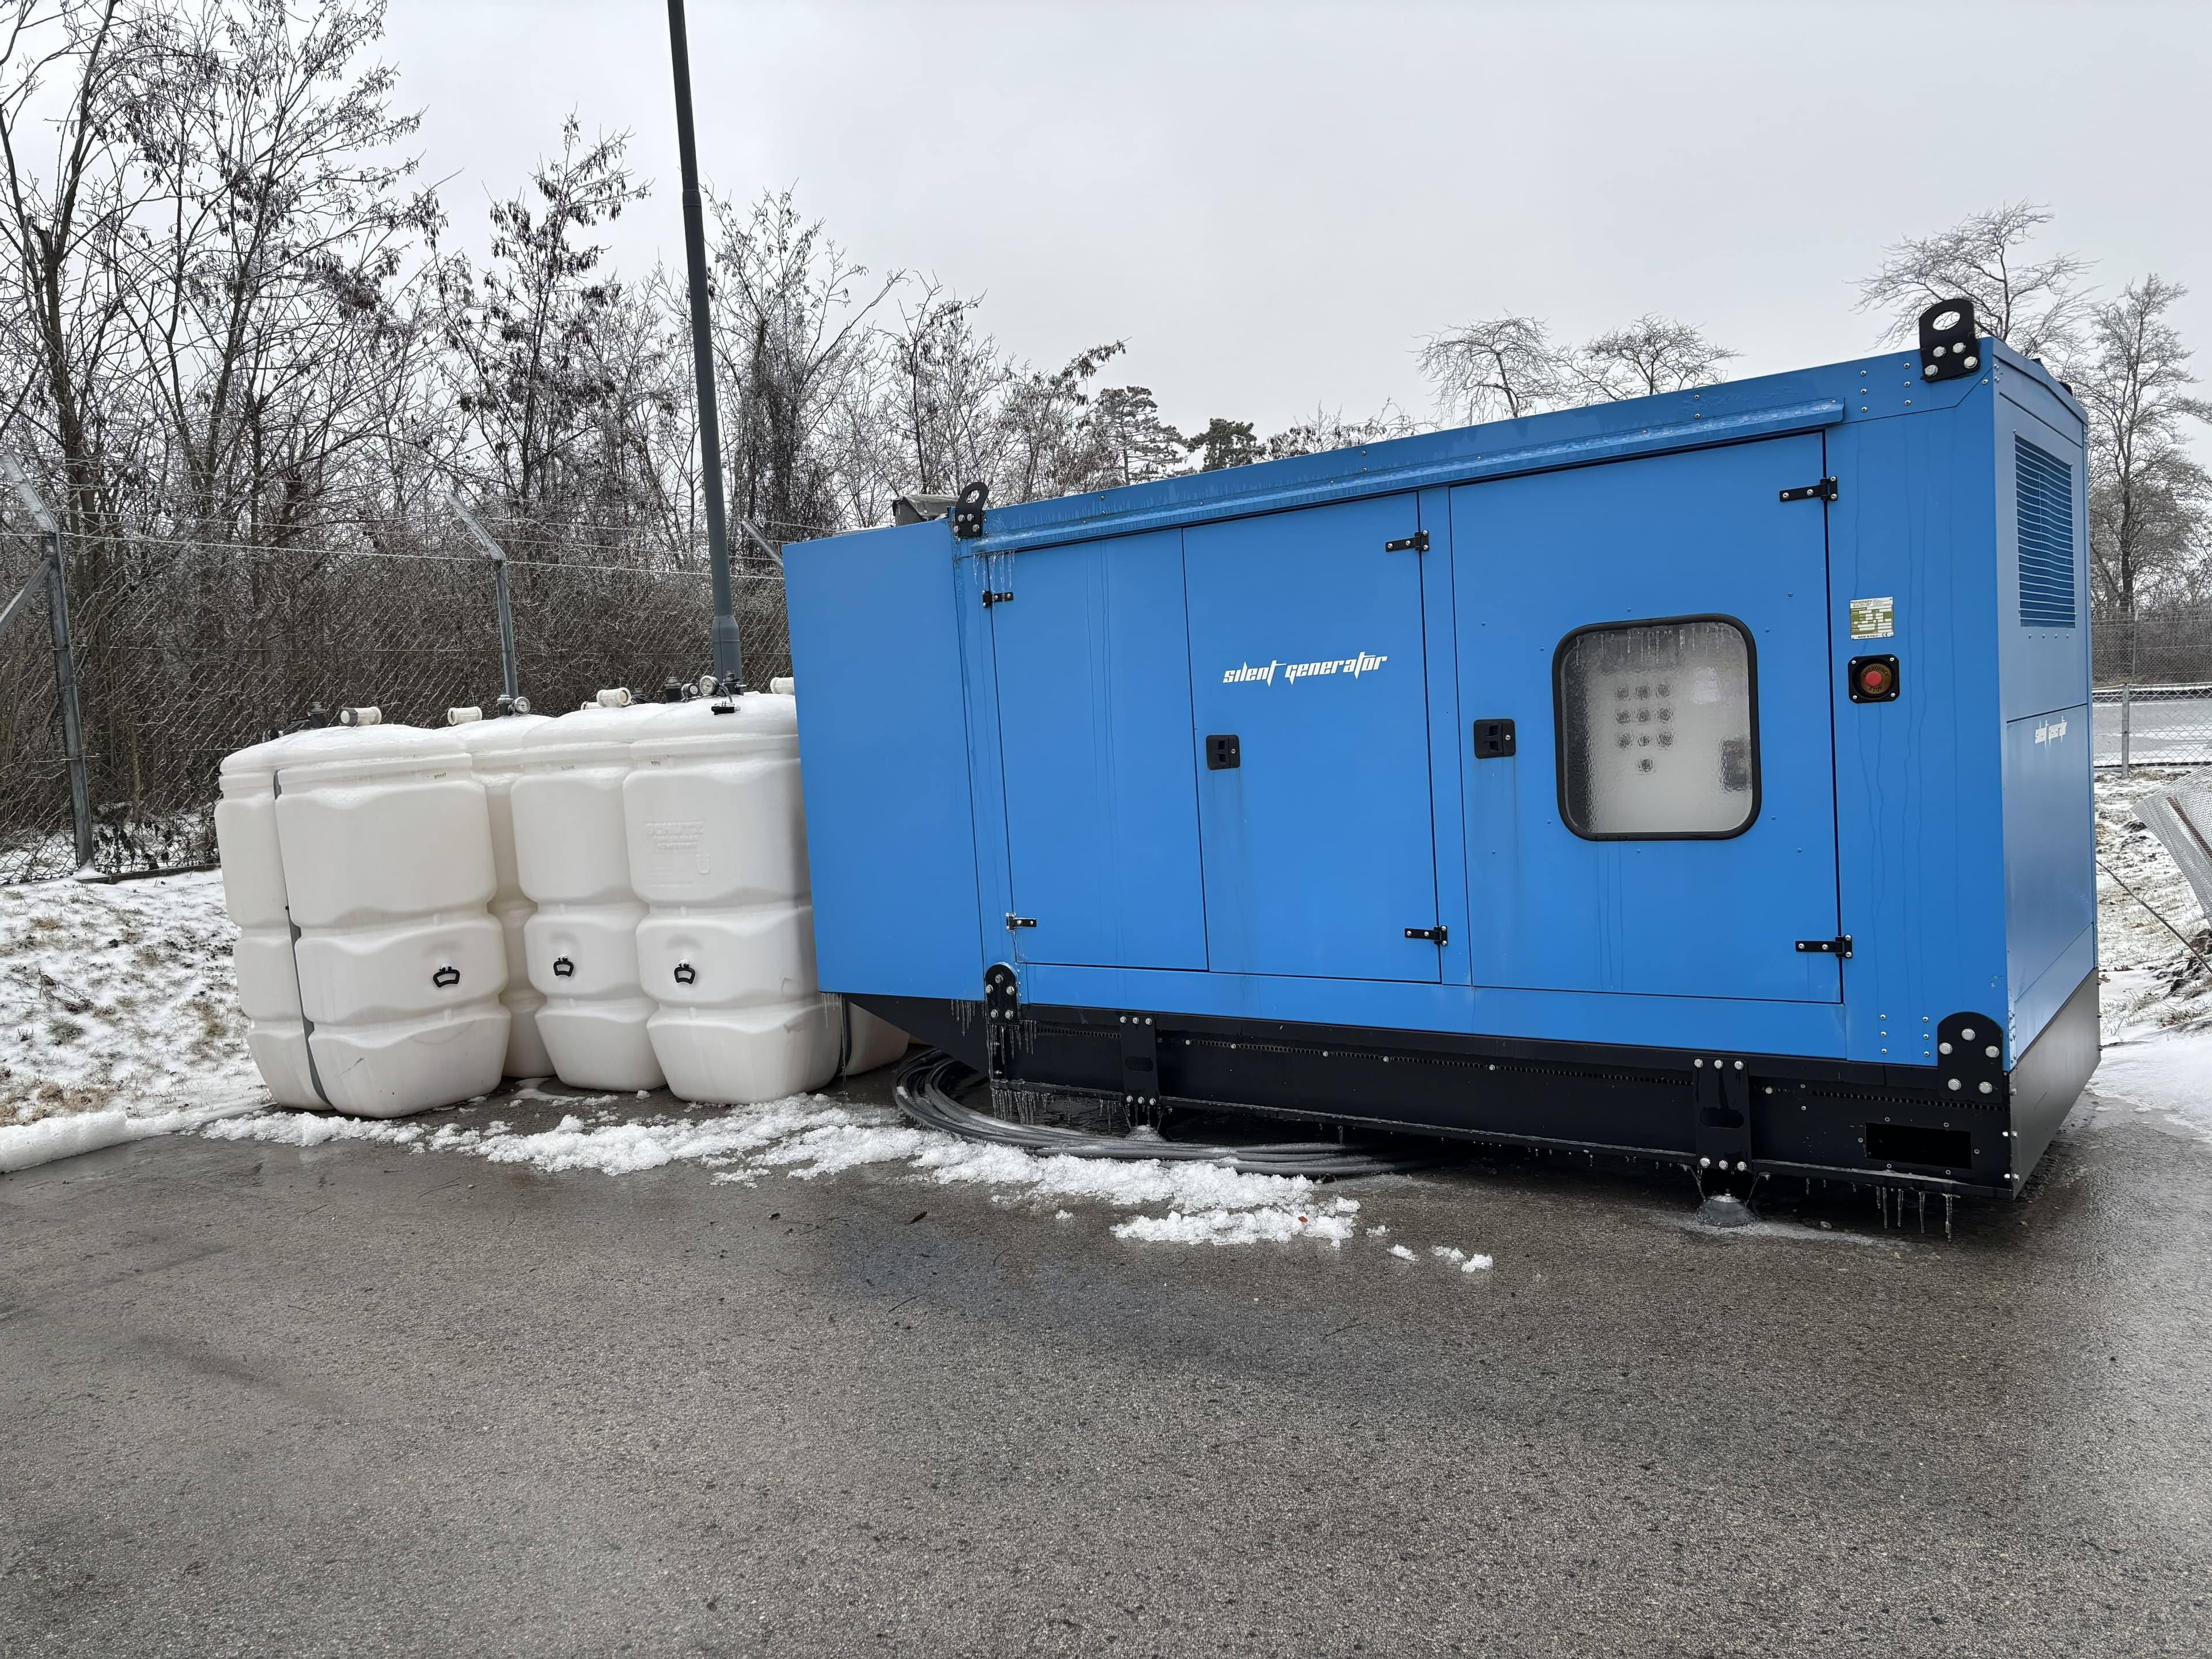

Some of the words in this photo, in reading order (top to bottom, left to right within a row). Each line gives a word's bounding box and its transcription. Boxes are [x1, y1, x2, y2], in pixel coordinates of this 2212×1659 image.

[1222, 660, 1287, 687] silent
[1285, 651, 1388, 685] generator
[1863, 665, 1889, 677] EMERGENCY
